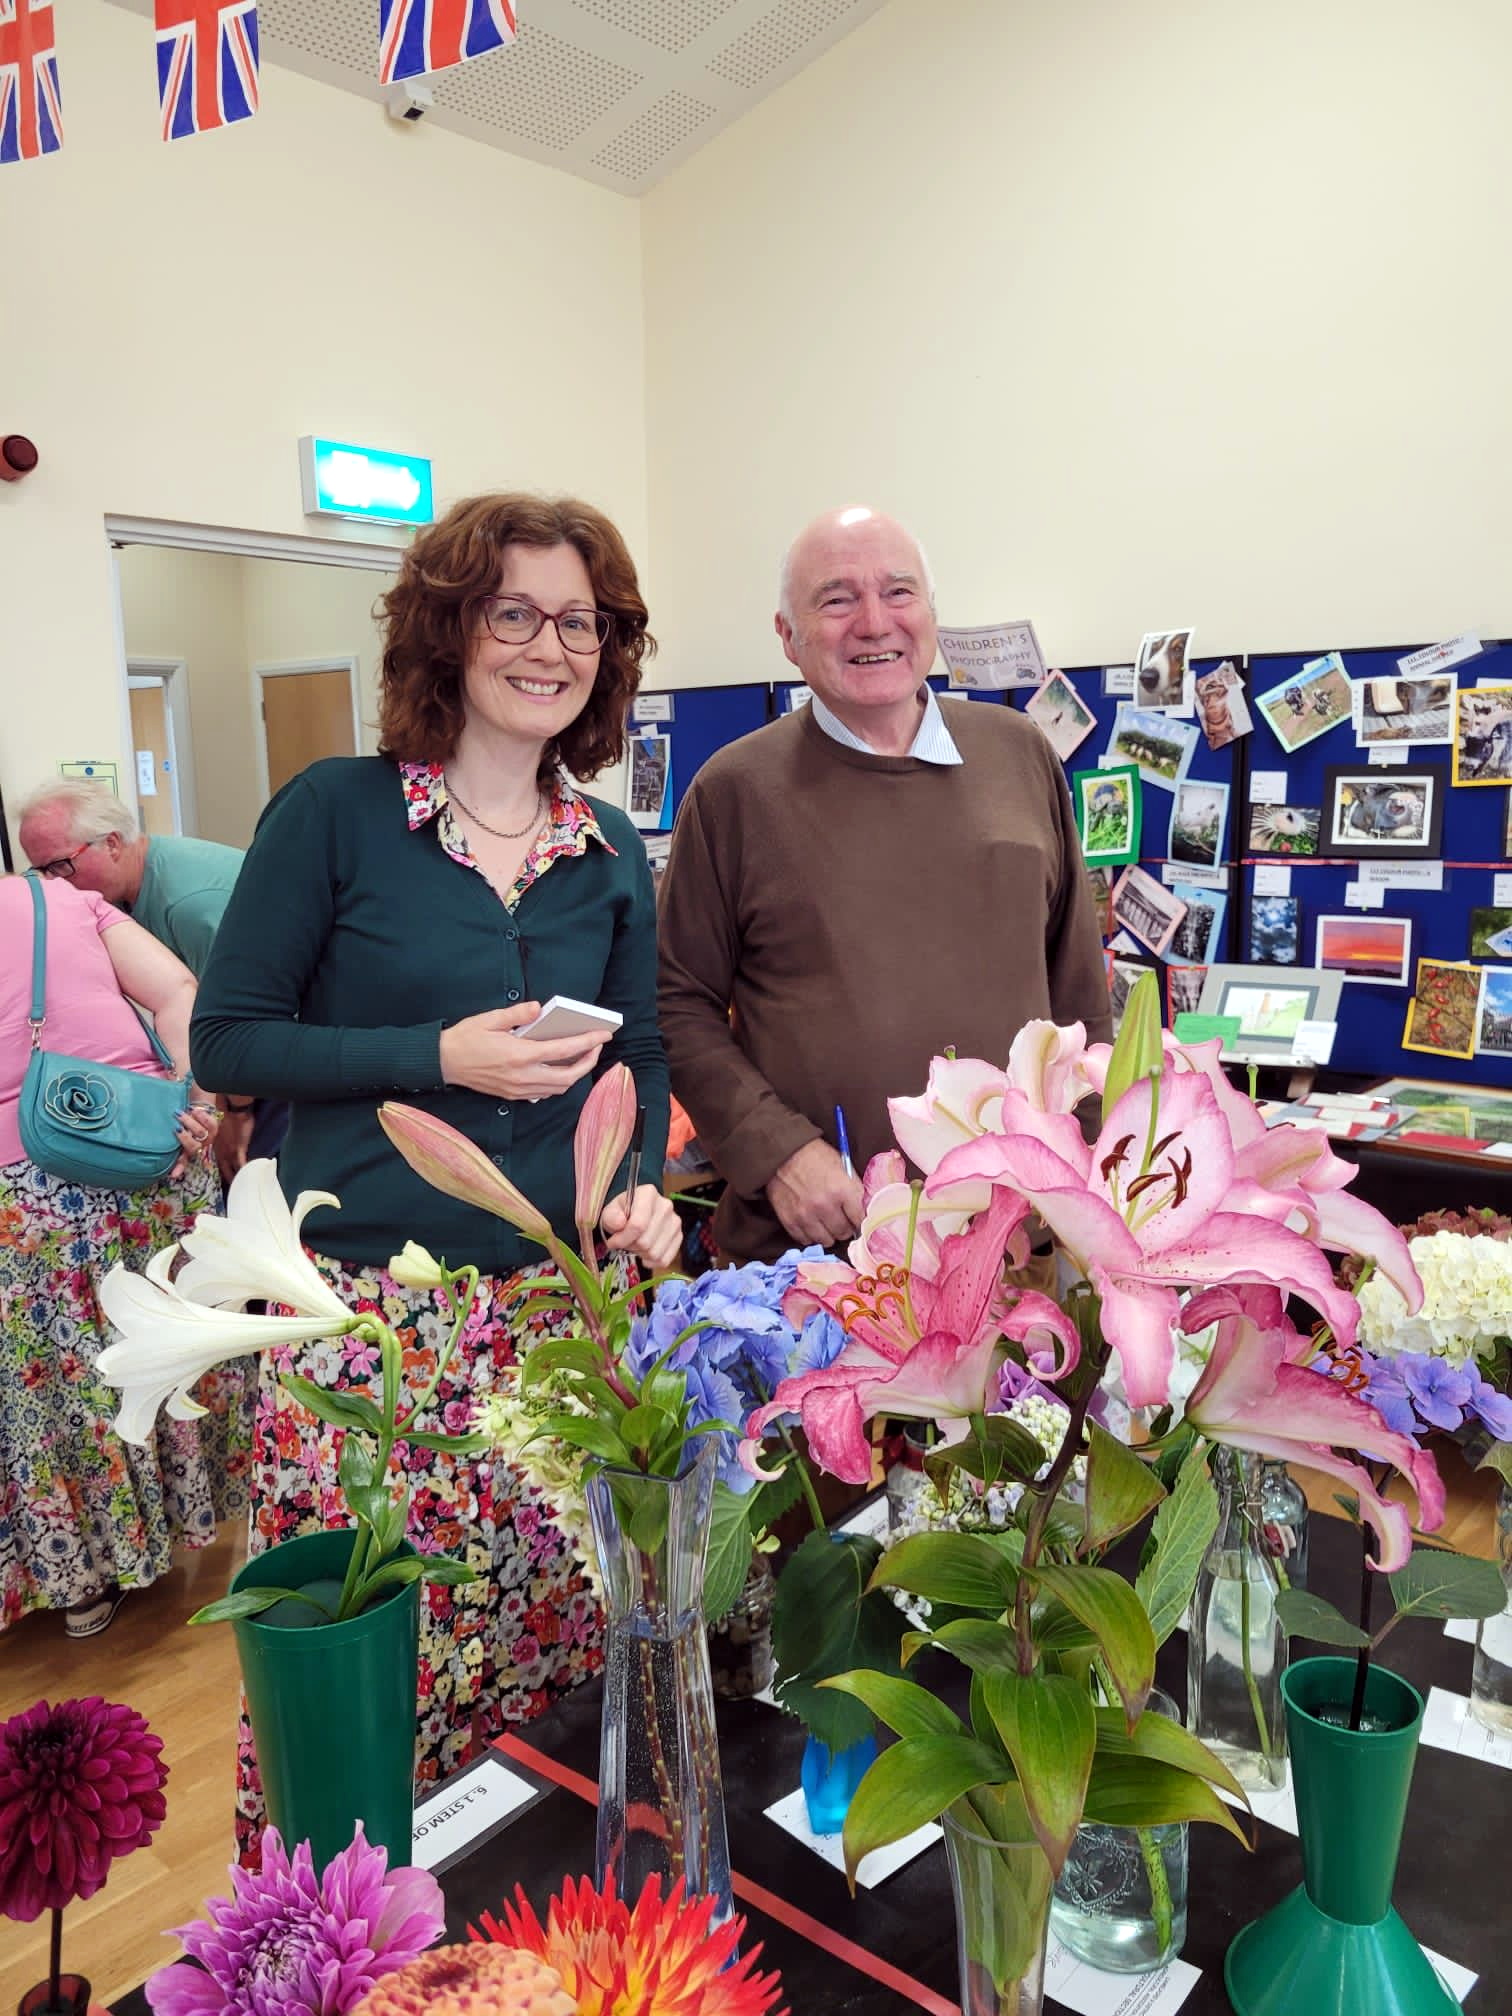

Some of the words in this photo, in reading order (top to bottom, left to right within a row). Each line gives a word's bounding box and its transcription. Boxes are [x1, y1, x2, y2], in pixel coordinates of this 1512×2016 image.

[942, 633, 1027, 651] CHILDREN'S
[949, 651, 1031, 666] PHOTOGRAPHY
[473, 1786, 488, 1796] 6.
[464, 1795, 474, 1803] 1
[429, 1801, 465, 1828] STEM
